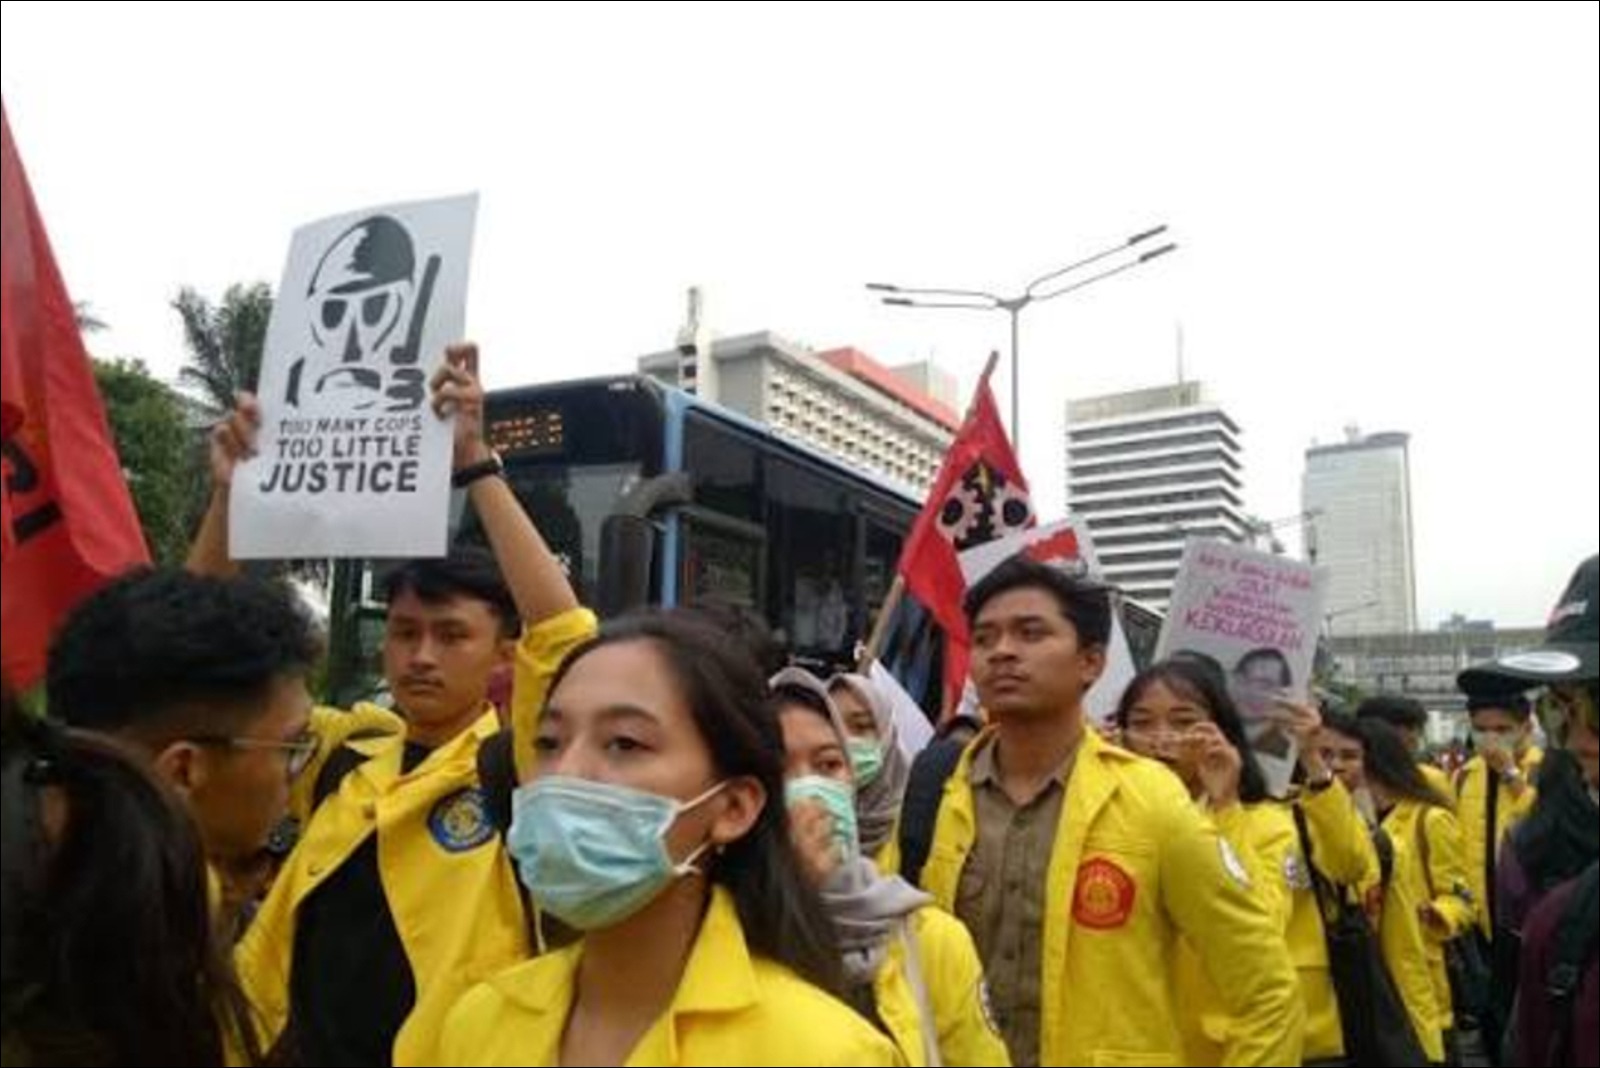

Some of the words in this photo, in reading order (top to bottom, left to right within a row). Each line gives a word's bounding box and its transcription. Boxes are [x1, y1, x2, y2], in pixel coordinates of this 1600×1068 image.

[279, 417, 311, 436] TOO
[315, 417, 368, 435] MANY
[373, 414, 423, 433] COPS
[276, 438, 323, 459] TOO
[331, 434, 423, 458] LITTLE
[259, 460, 419, 494] JUSTICE
